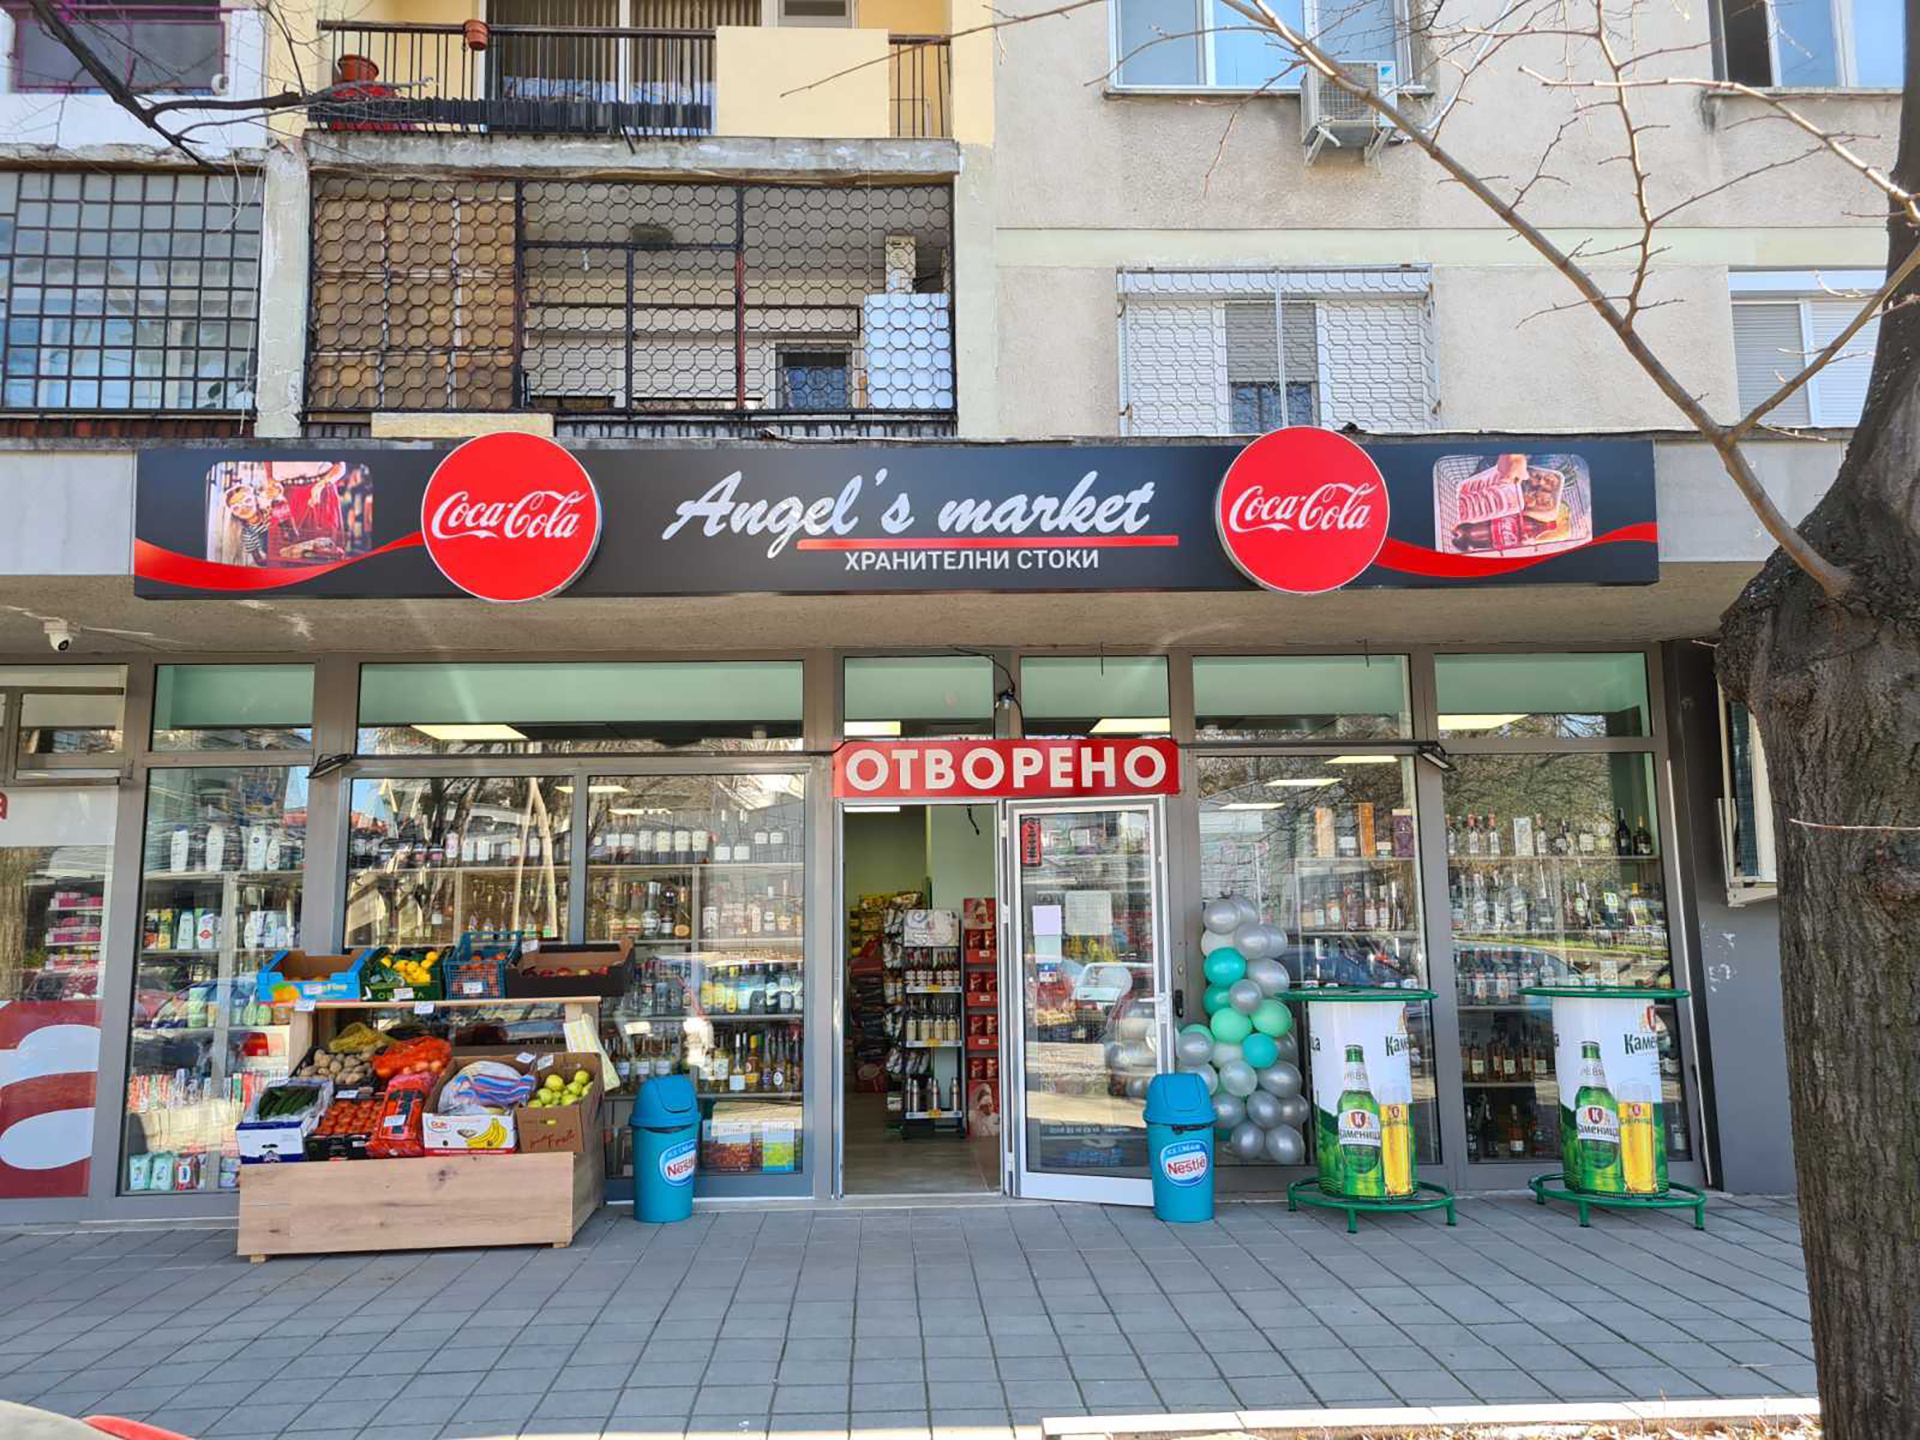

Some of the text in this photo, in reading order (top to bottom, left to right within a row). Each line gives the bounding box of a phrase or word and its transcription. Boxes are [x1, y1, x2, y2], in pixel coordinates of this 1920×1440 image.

[431, 490, 588, 540] Coca-Cola
[662, 468, 1156, 559] Angel's market
[1228, 482, 1380, 534] Coca-Cola
[844, 548, 1100, 571] ХРАНИТЕЛНИ СТОКИ
[846, 745, 1167, 792] ОТВОРЕНО
